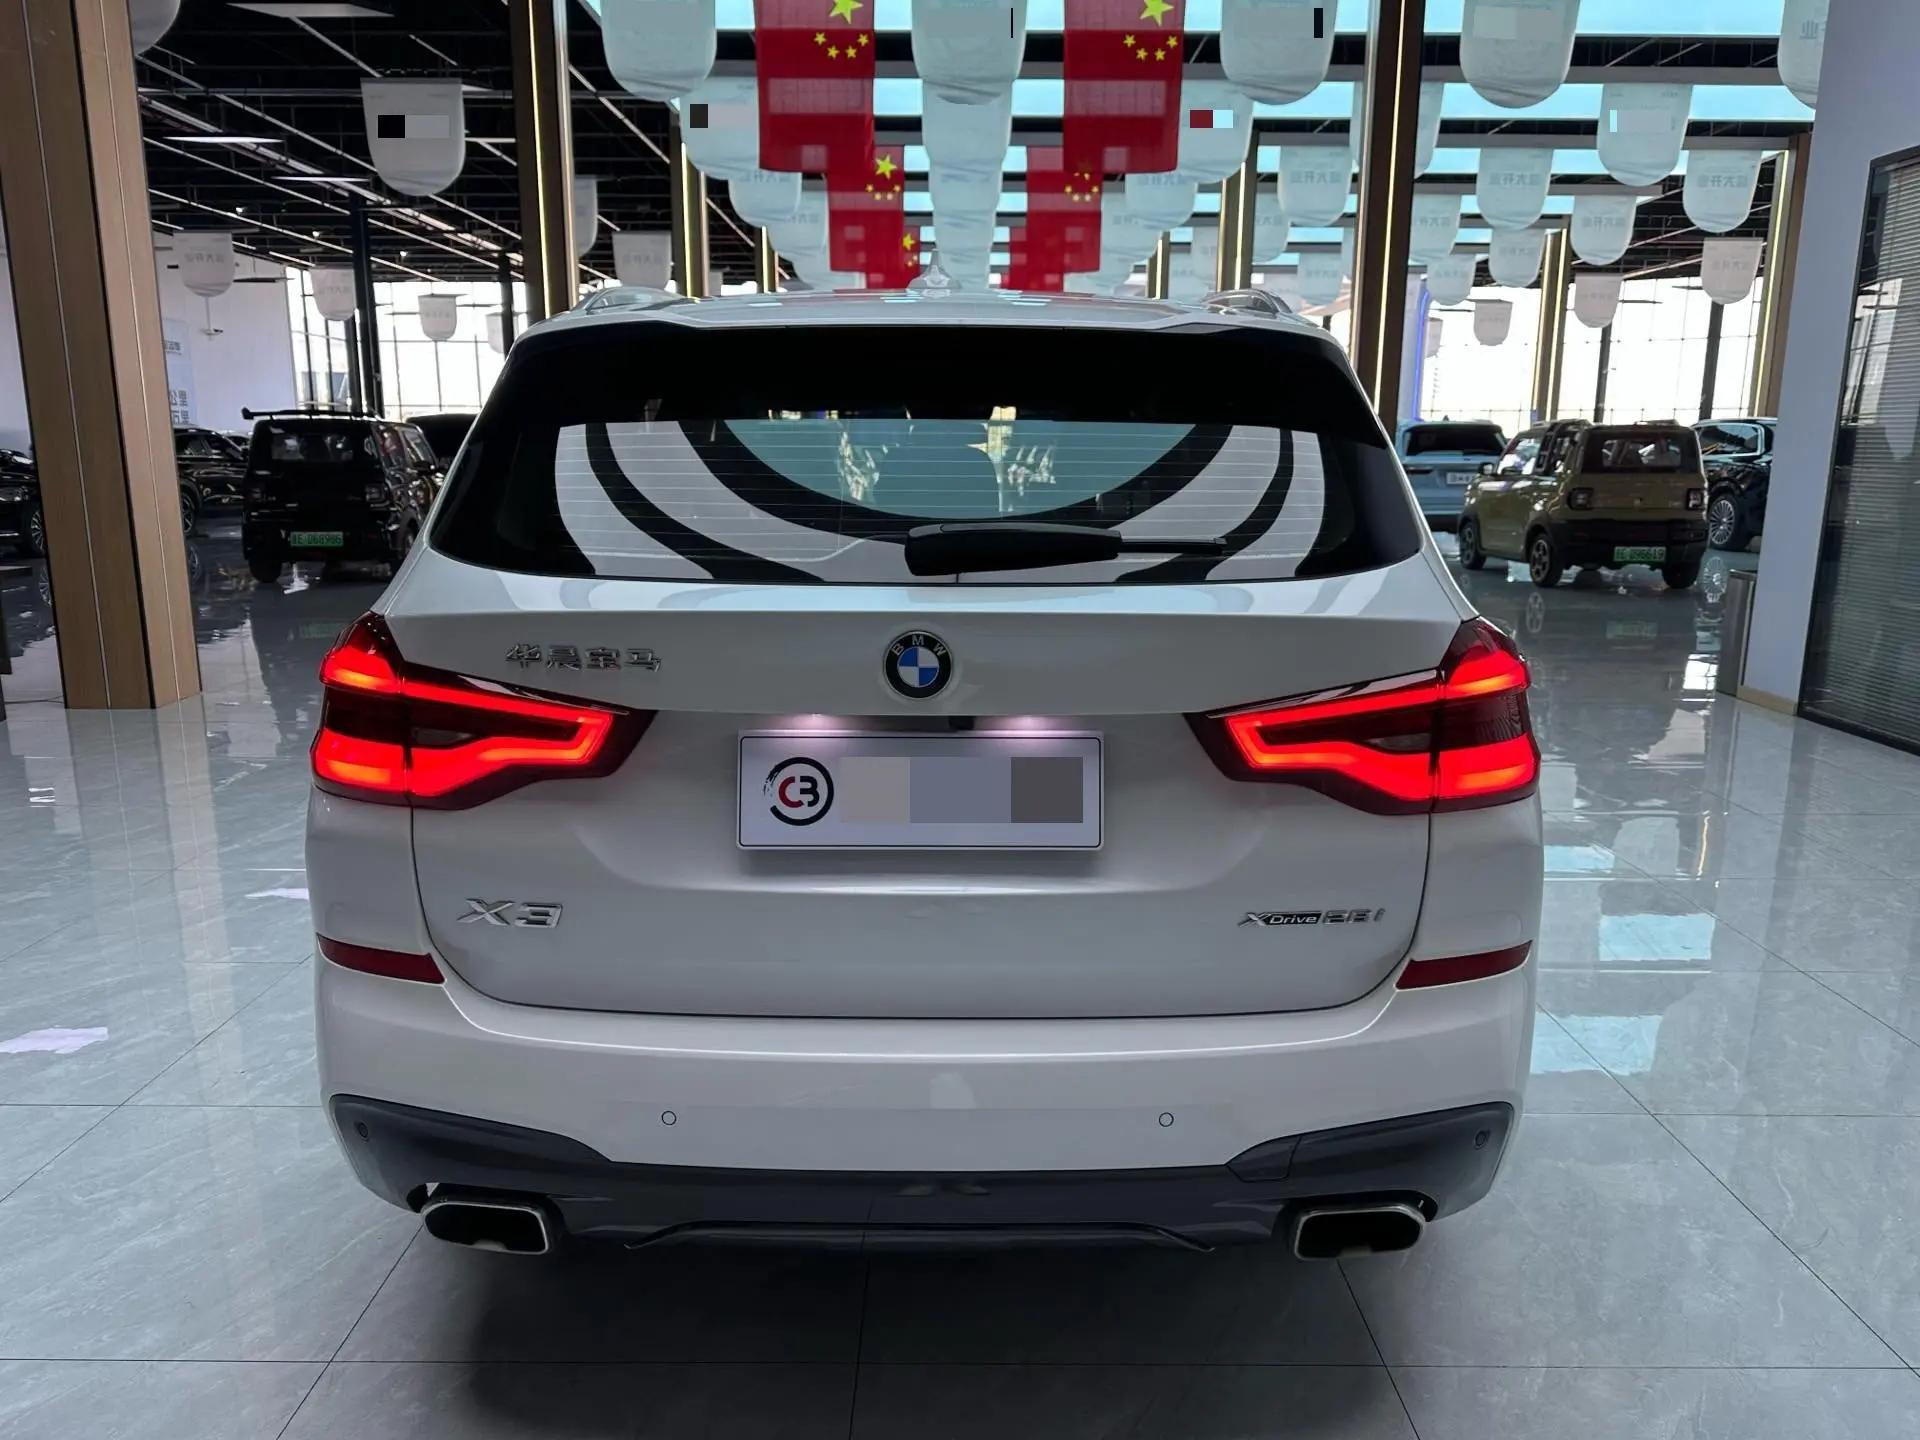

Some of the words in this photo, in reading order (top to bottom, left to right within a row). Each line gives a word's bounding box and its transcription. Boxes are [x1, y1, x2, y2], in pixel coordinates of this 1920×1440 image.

[506, 644, 661, 672] 华晨宝马
[891, 634, 947, 656] BMW
[457, 898, 562, 928] X3
